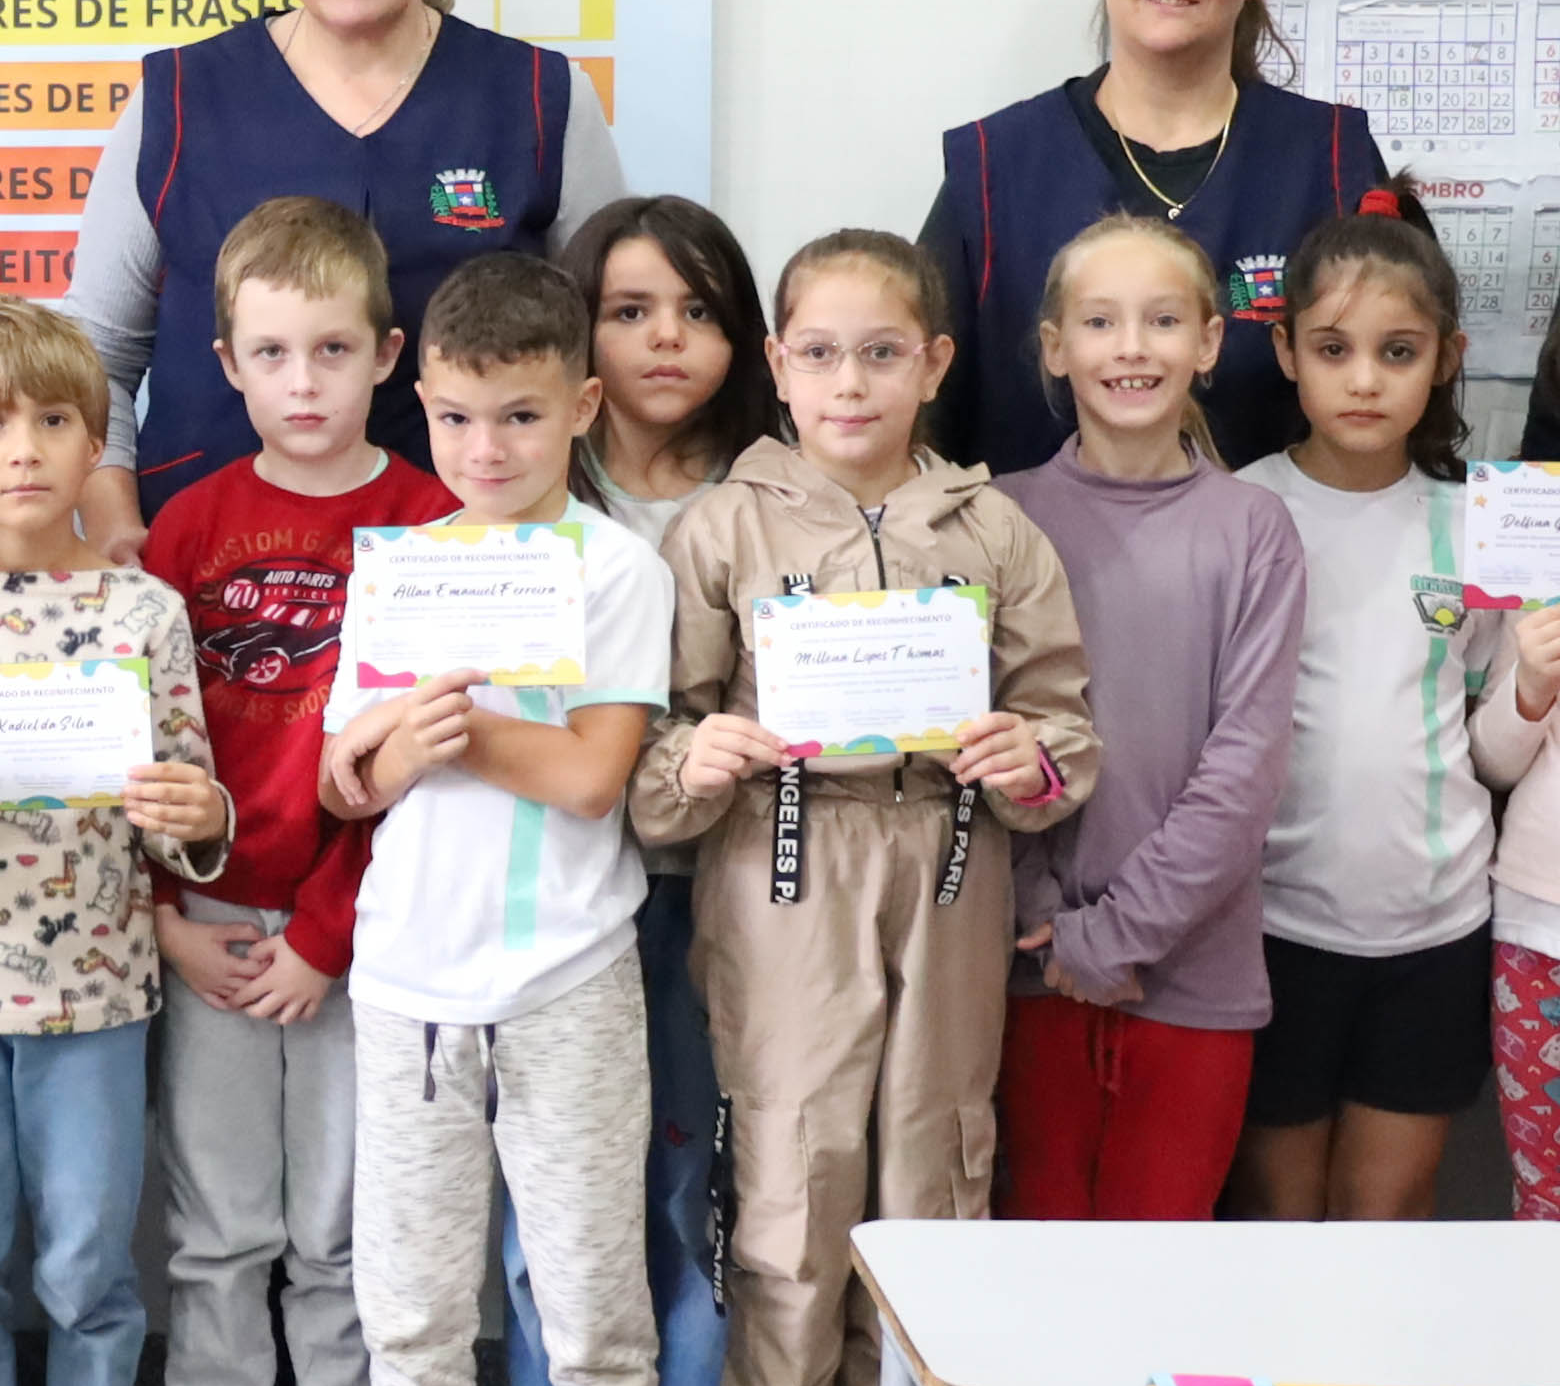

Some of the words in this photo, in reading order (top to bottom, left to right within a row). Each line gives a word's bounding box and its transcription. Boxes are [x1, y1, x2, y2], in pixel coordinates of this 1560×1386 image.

[47, 82, 95, 114] DE
[264, 570, 295, 585] AUTO
[296, 572, 336, 588] PARTS
[776, 767, 799, 873] NGELES
[937, 831, 968, 905] PARIS
